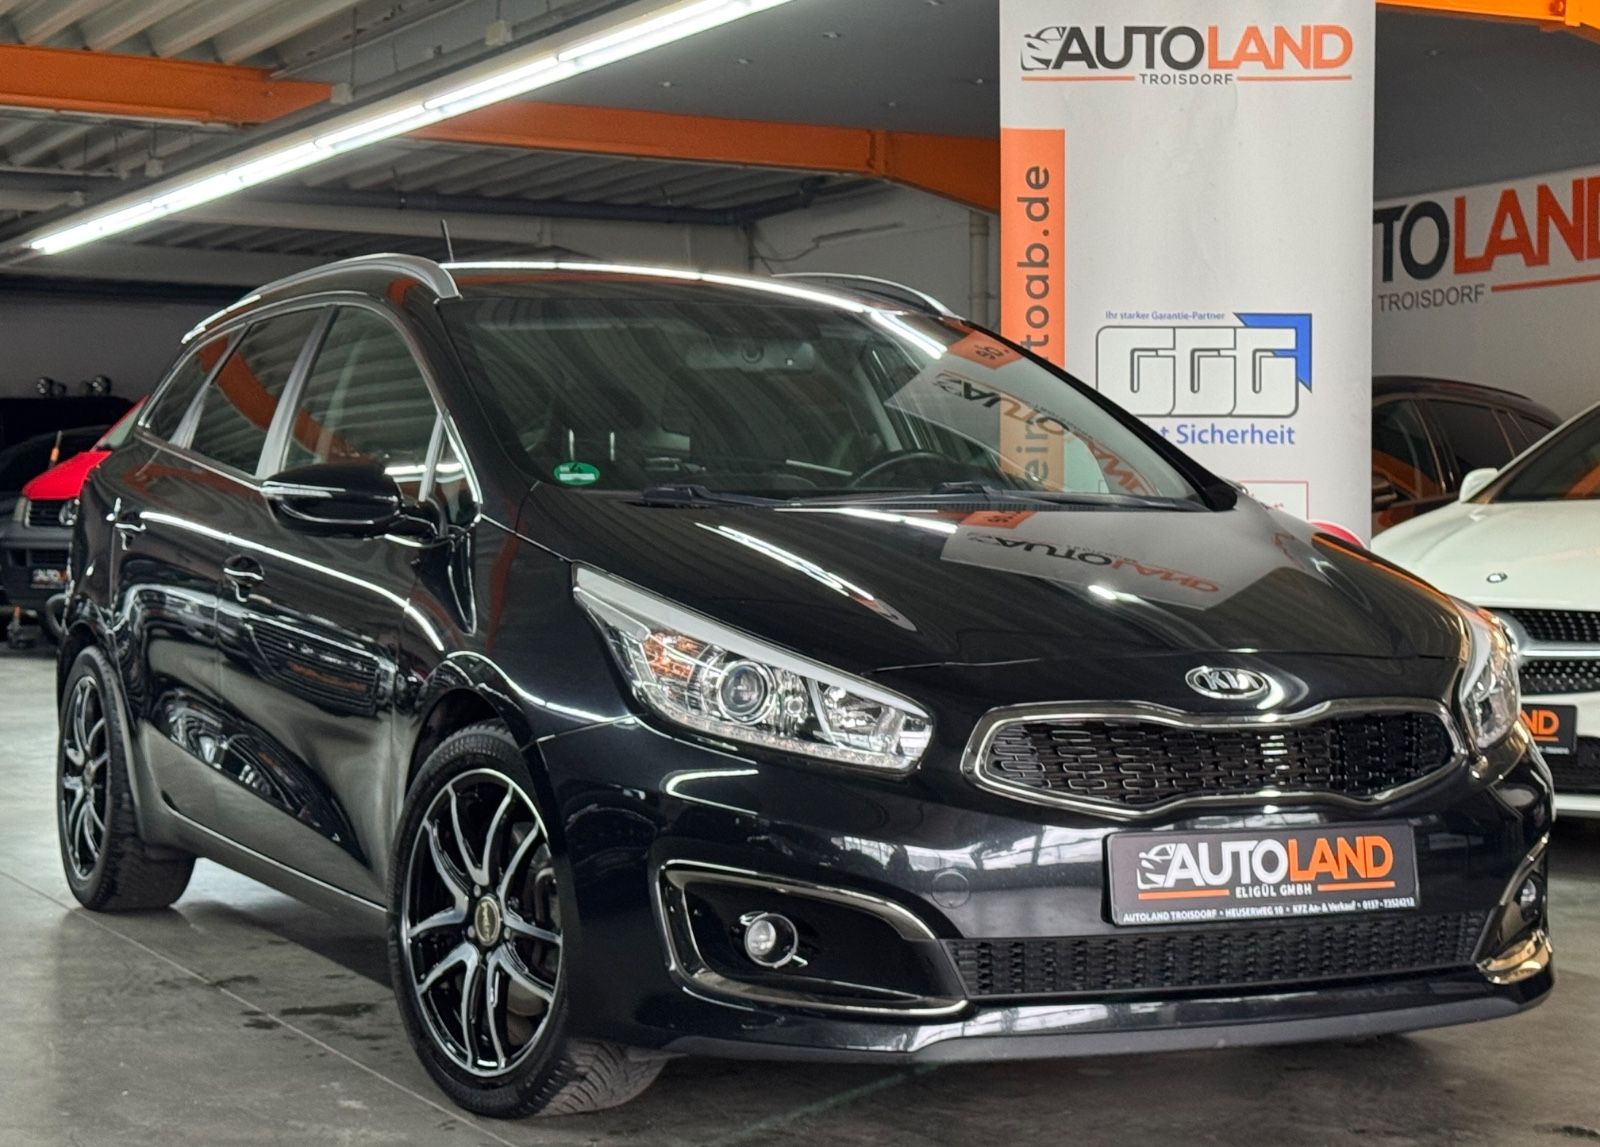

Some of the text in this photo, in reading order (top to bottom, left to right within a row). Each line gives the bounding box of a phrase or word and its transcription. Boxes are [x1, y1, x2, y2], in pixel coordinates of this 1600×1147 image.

[1050, 25, 1353, 71] AUTOLAND
[1139, 73, 1234, 86] TROISDORF
[1377, 284, 1486, 313] TROISDORF
[1105, 311, 1225, 321] Ihr starker Garantie-Partner
[1176, 423, 1296, 445] Sicherheit
[1200, 671, 1260, 690] KIA
[1163, 835, 1394, 888] AUTOLAND
[1235, 883, 1313, 899] ELIGÜL GMBH
[1123, 911, 1169, 923] AUTOLAND
[1171, 909, 1217, 921] TROISDORF
